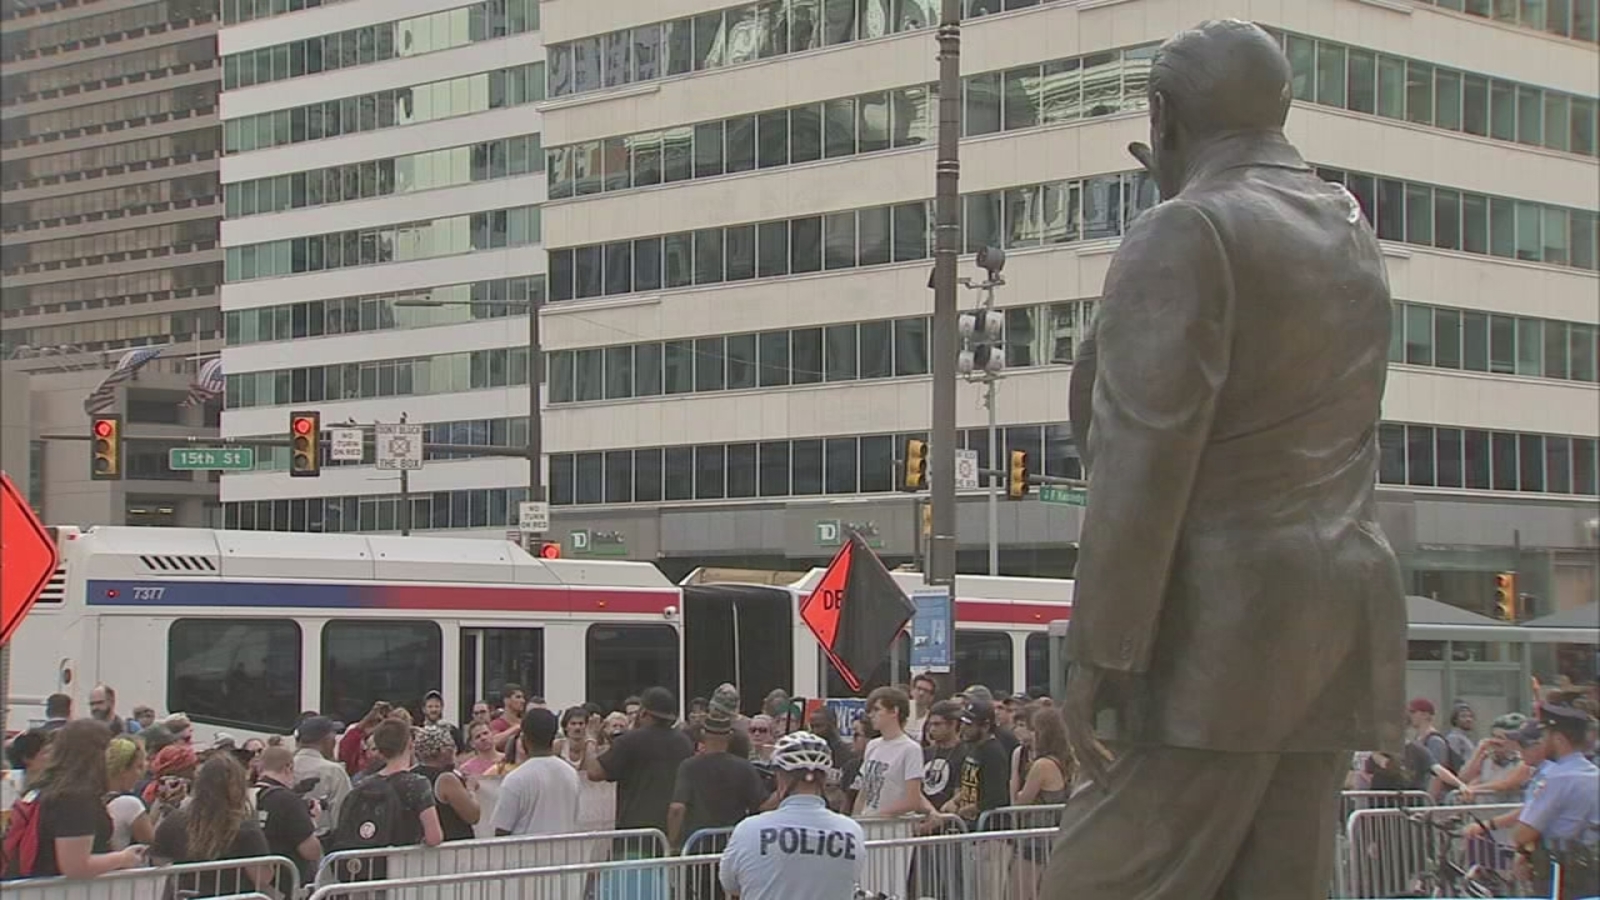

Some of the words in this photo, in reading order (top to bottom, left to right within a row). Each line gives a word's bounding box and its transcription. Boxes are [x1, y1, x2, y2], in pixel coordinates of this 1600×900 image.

[181, 452, 215, 465] 15th
[224, 452, 241, 465] St
[334, 448, 345, 456] ON
[346, 448, 361, 456] RED
[380, 459, 396, 468] THE
[401, 459, 419, 468] BOX
[521, 521, 531, 529] ON
[533, 521, 548, 529] RED
[817, 523, 836, 540] TD
[570, 532, 587, 548] TD
[133, 586, 166, 600] 7377
